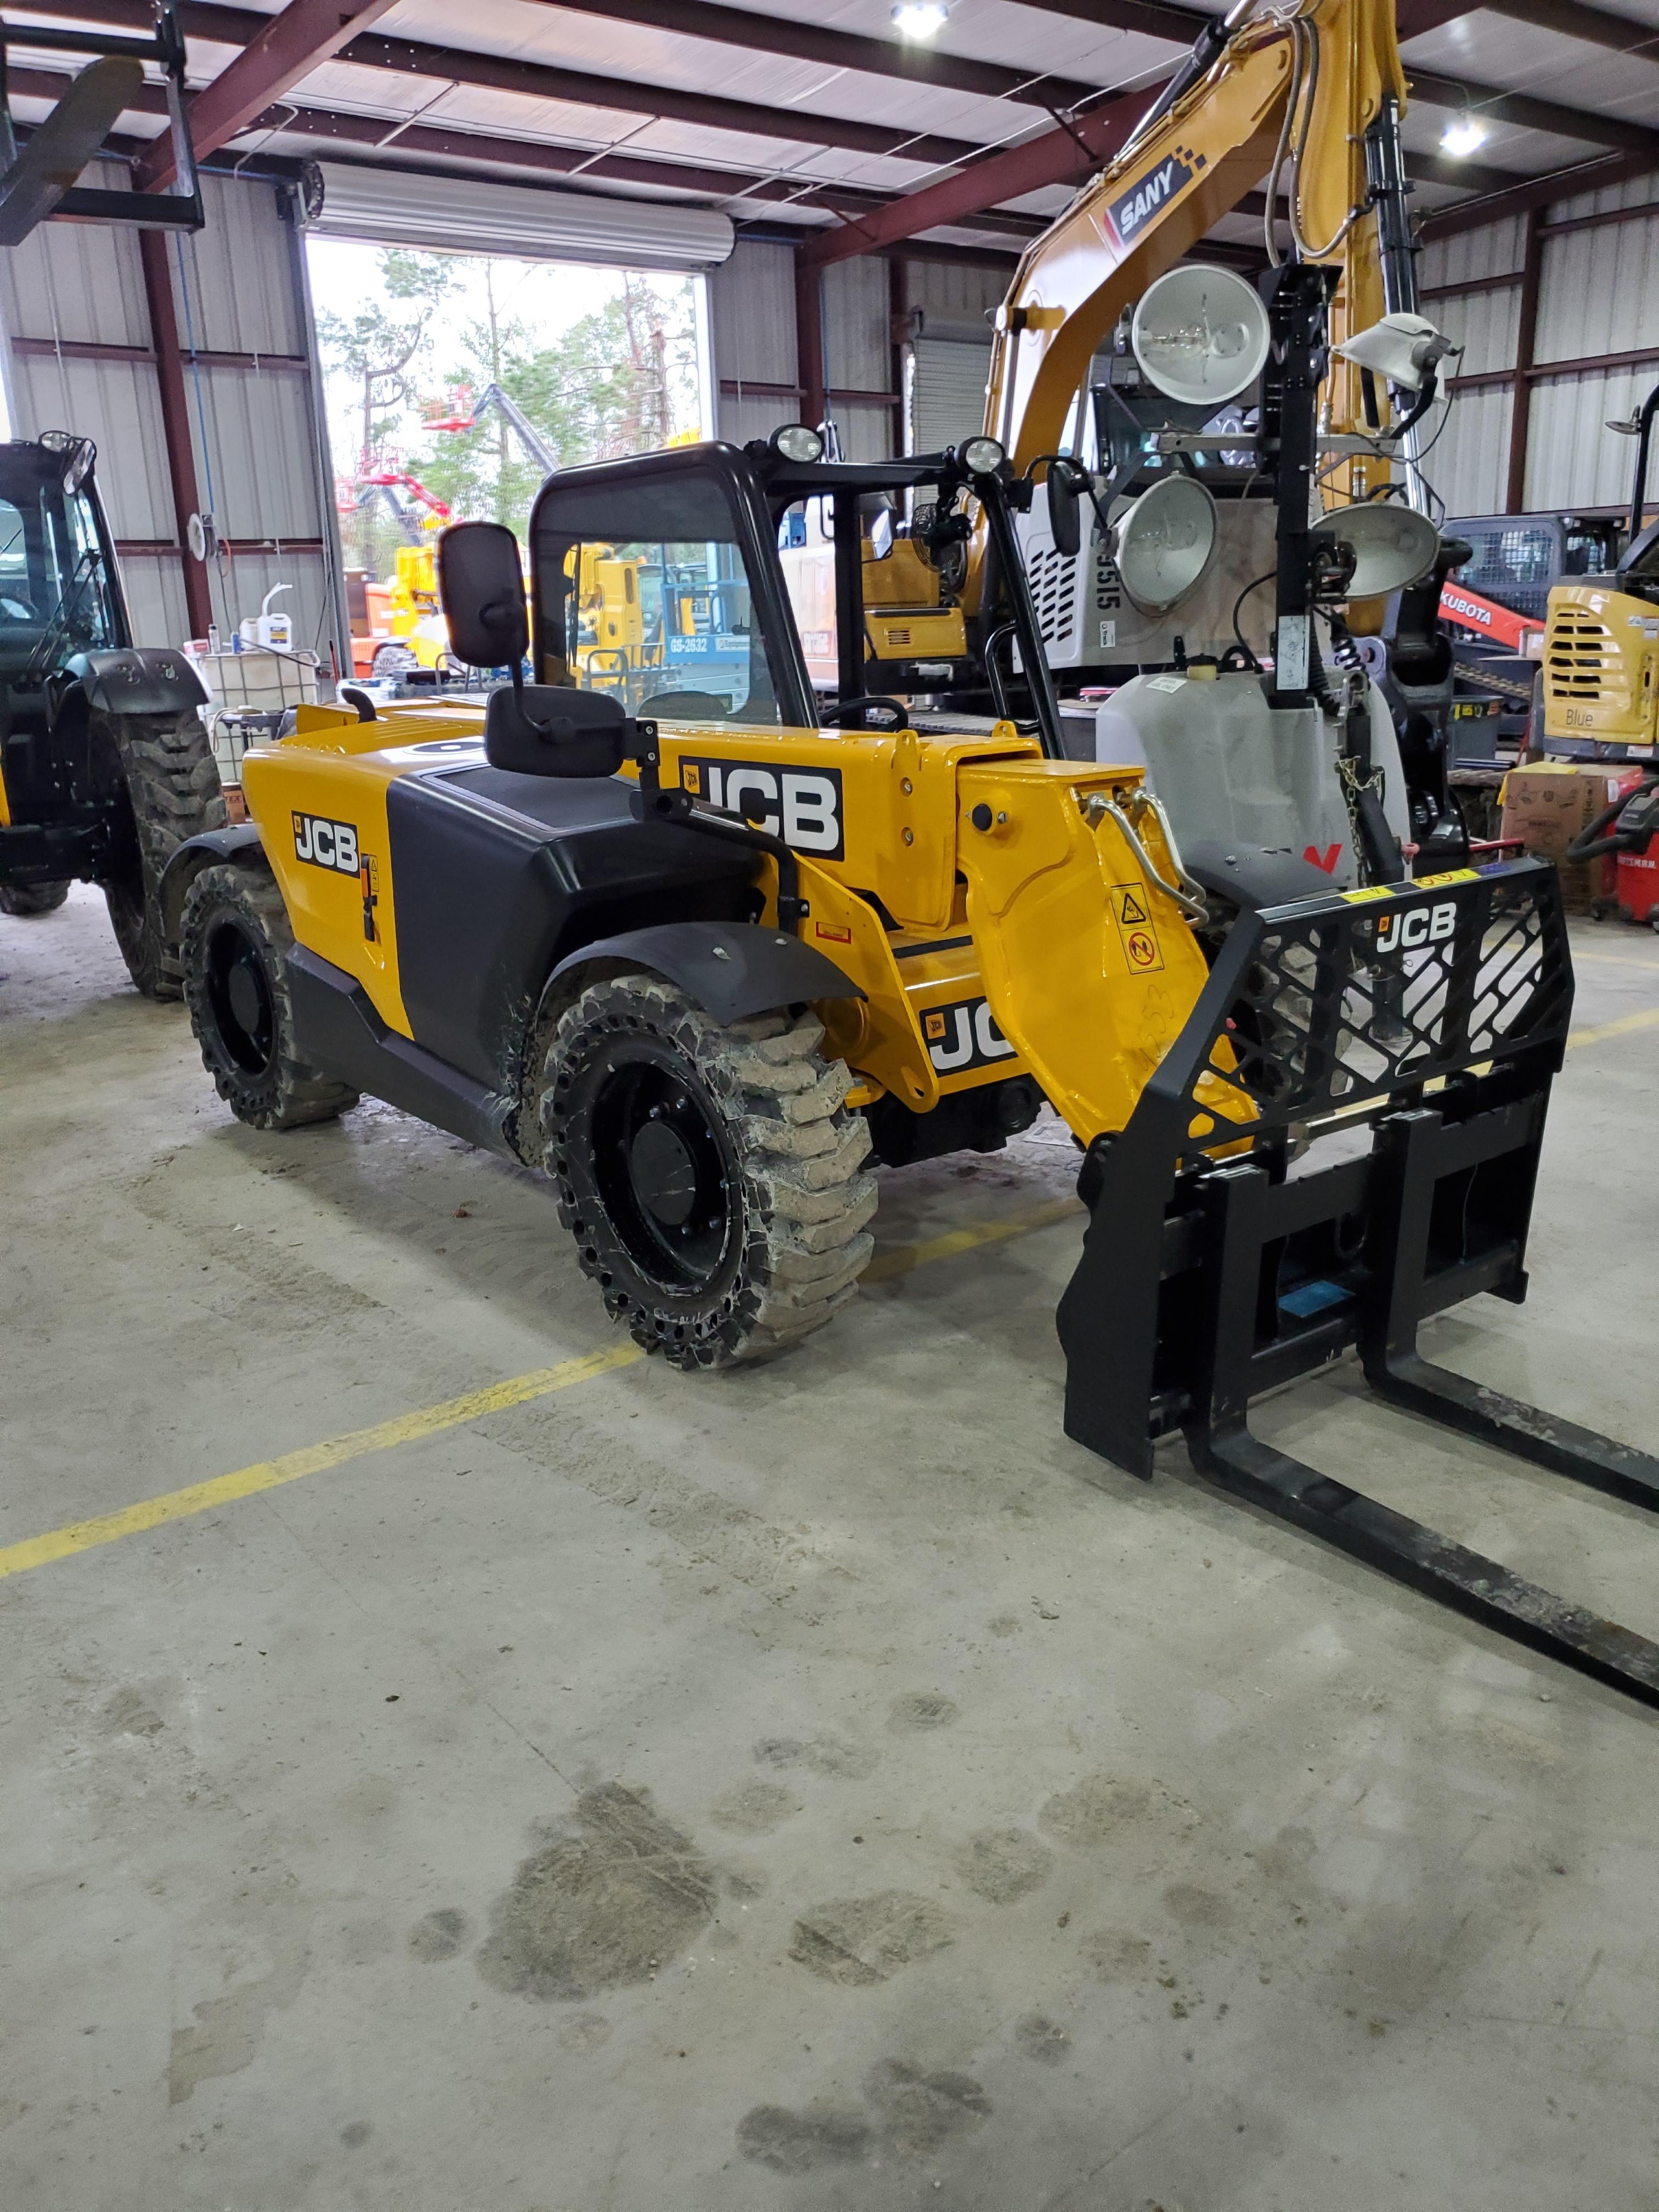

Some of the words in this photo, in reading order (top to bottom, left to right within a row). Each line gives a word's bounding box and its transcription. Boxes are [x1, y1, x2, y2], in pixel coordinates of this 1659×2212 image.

[1120, 161, 1173, 235] SANY
[1440, 590, 1492, 625] KUBOTA
[670, 637, 708, 653] GS-2632
[1566, 708, 1593, 727] Blue
[296, 817, 358, 872] JCB
[1377, 902, 1457, 952] JCB
[929, 1002, 1015, 1070] JC
